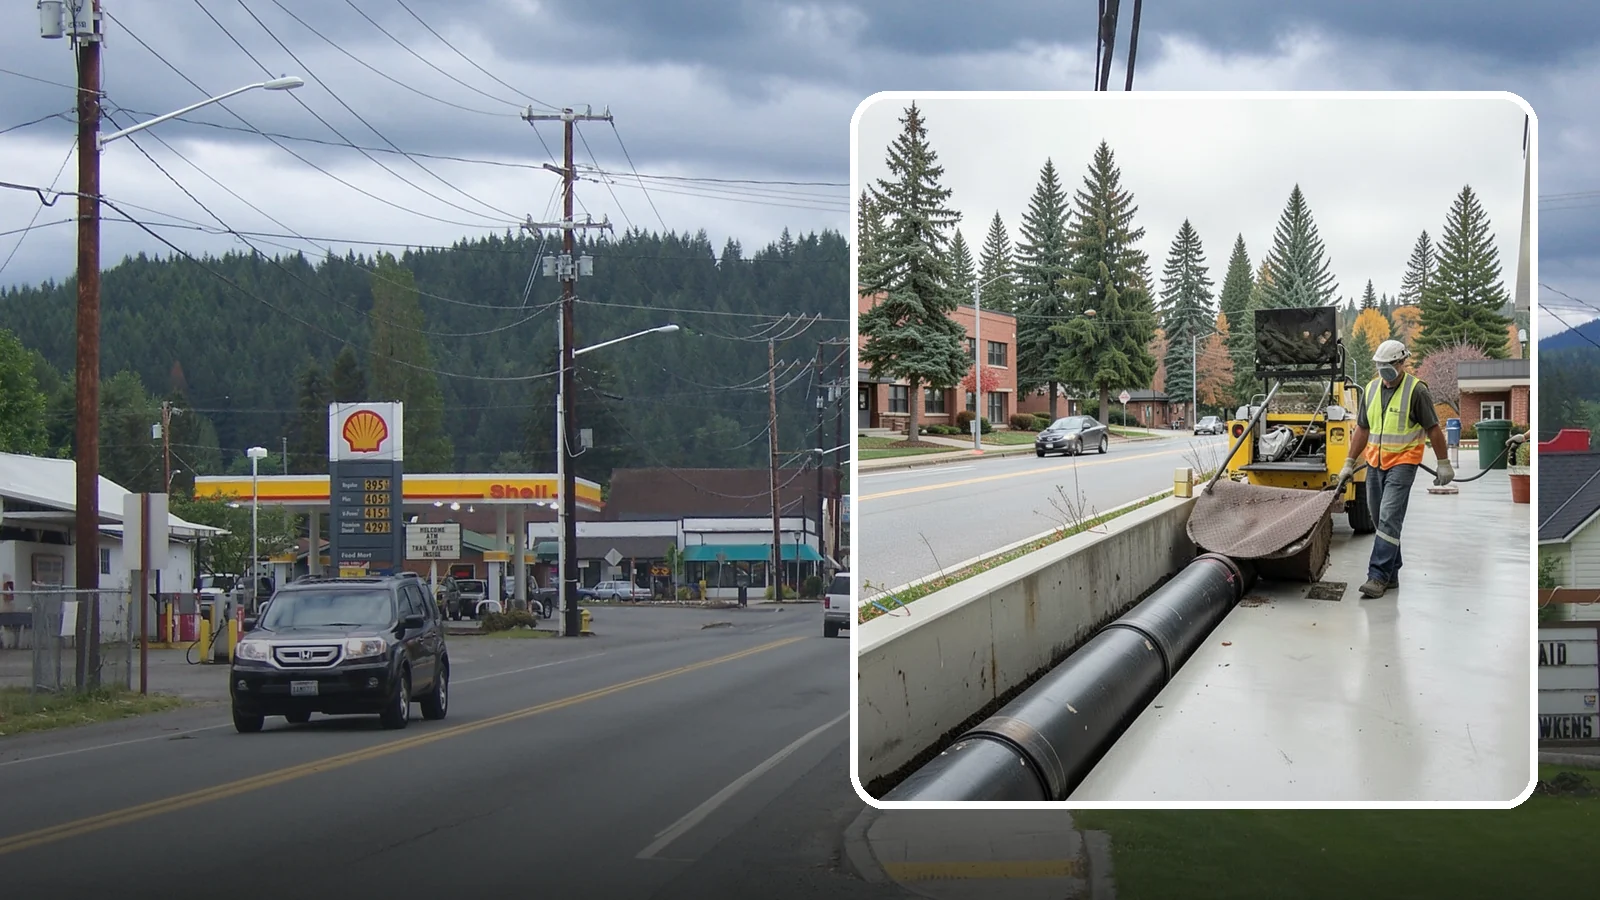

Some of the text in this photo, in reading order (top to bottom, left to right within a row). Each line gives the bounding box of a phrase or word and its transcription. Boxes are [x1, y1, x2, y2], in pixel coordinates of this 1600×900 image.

[366, 480, 384, 490] 395
[490, 484, 547, 499] Shell
[365, 494, 384, 504] 405
[365, 508, 383, 518] 415
[366, 522, 384, 532] 429
